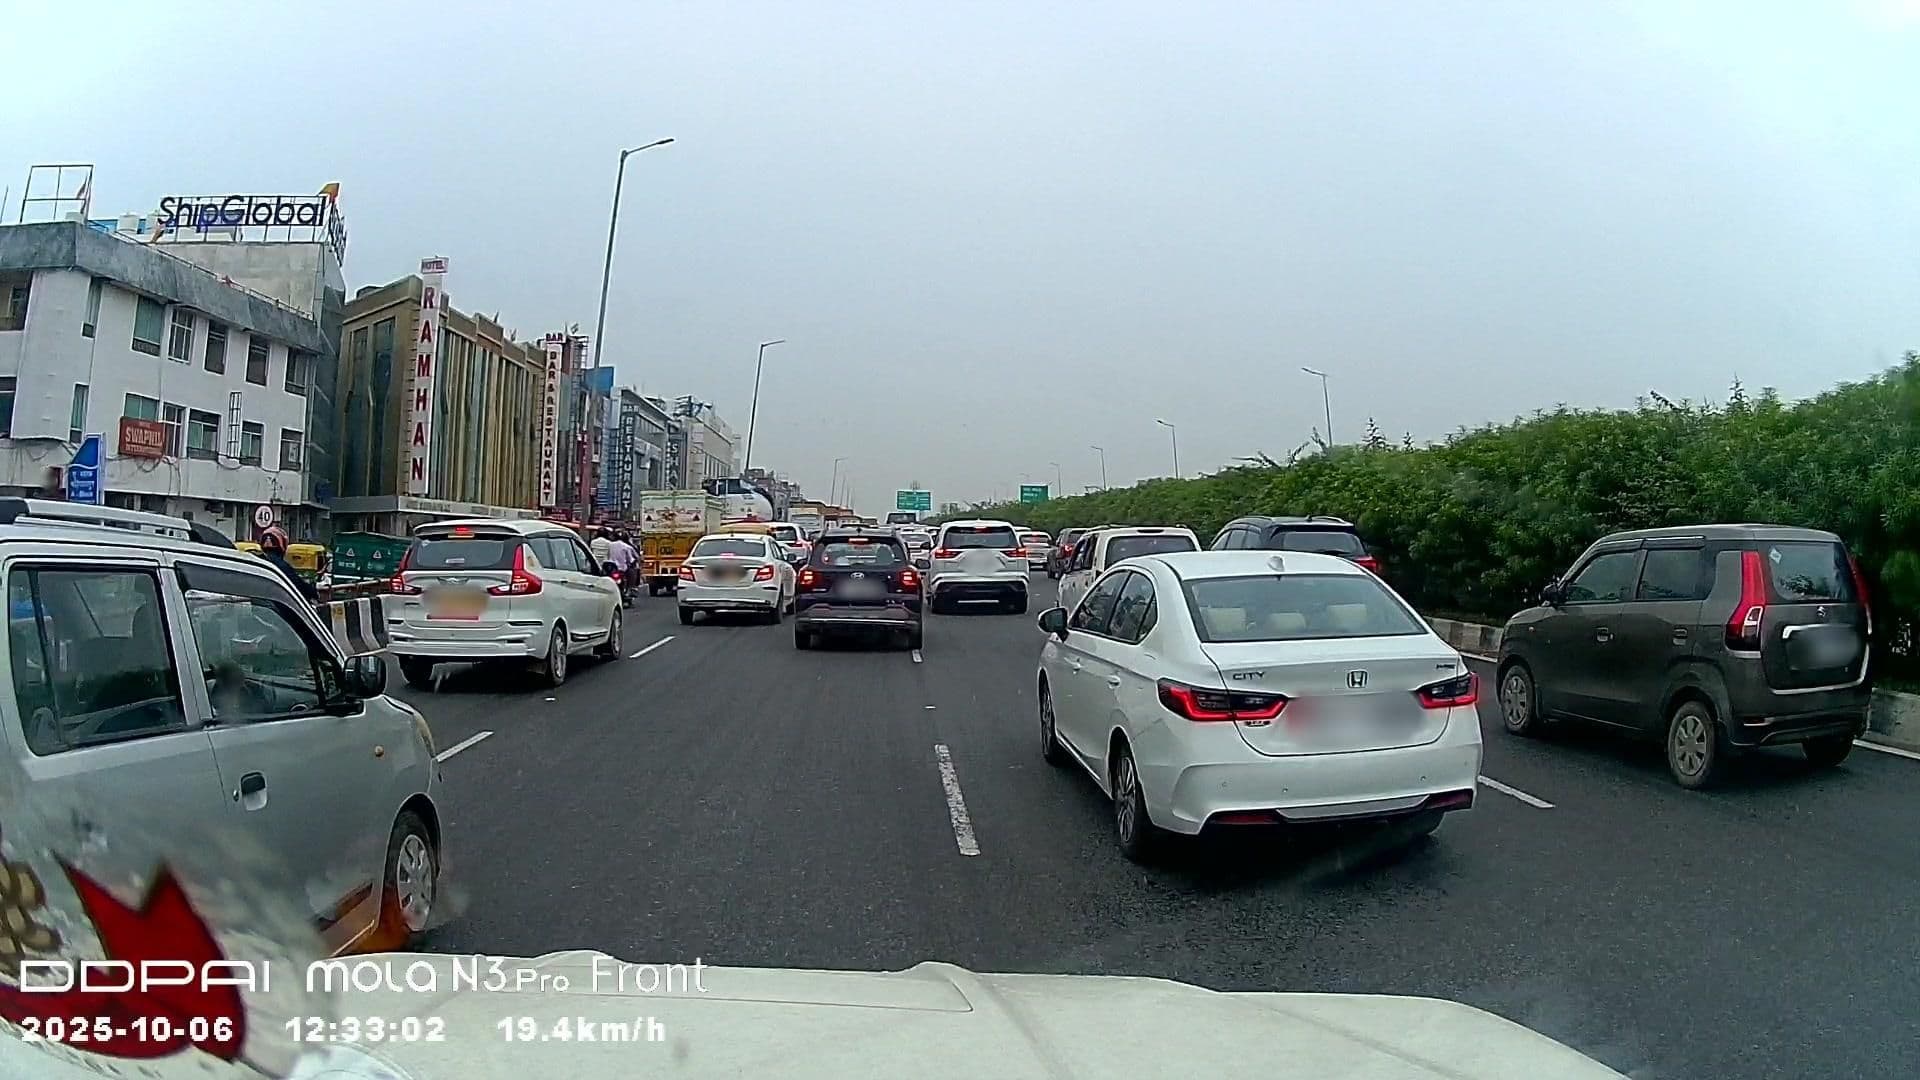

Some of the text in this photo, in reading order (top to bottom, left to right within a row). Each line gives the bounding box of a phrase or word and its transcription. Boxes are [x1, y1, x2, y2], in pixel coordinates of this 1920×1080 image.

[158, 195, 327, 233] ShipGlobal
[545, 333, 563, 342] BAR
[411, 286, 435, 481] RAMHAN
[621, 416, 633, 509] RESTAURANT
[257, 511, 270, 522] 40
[1232, 671, 1265, 681] CITY
